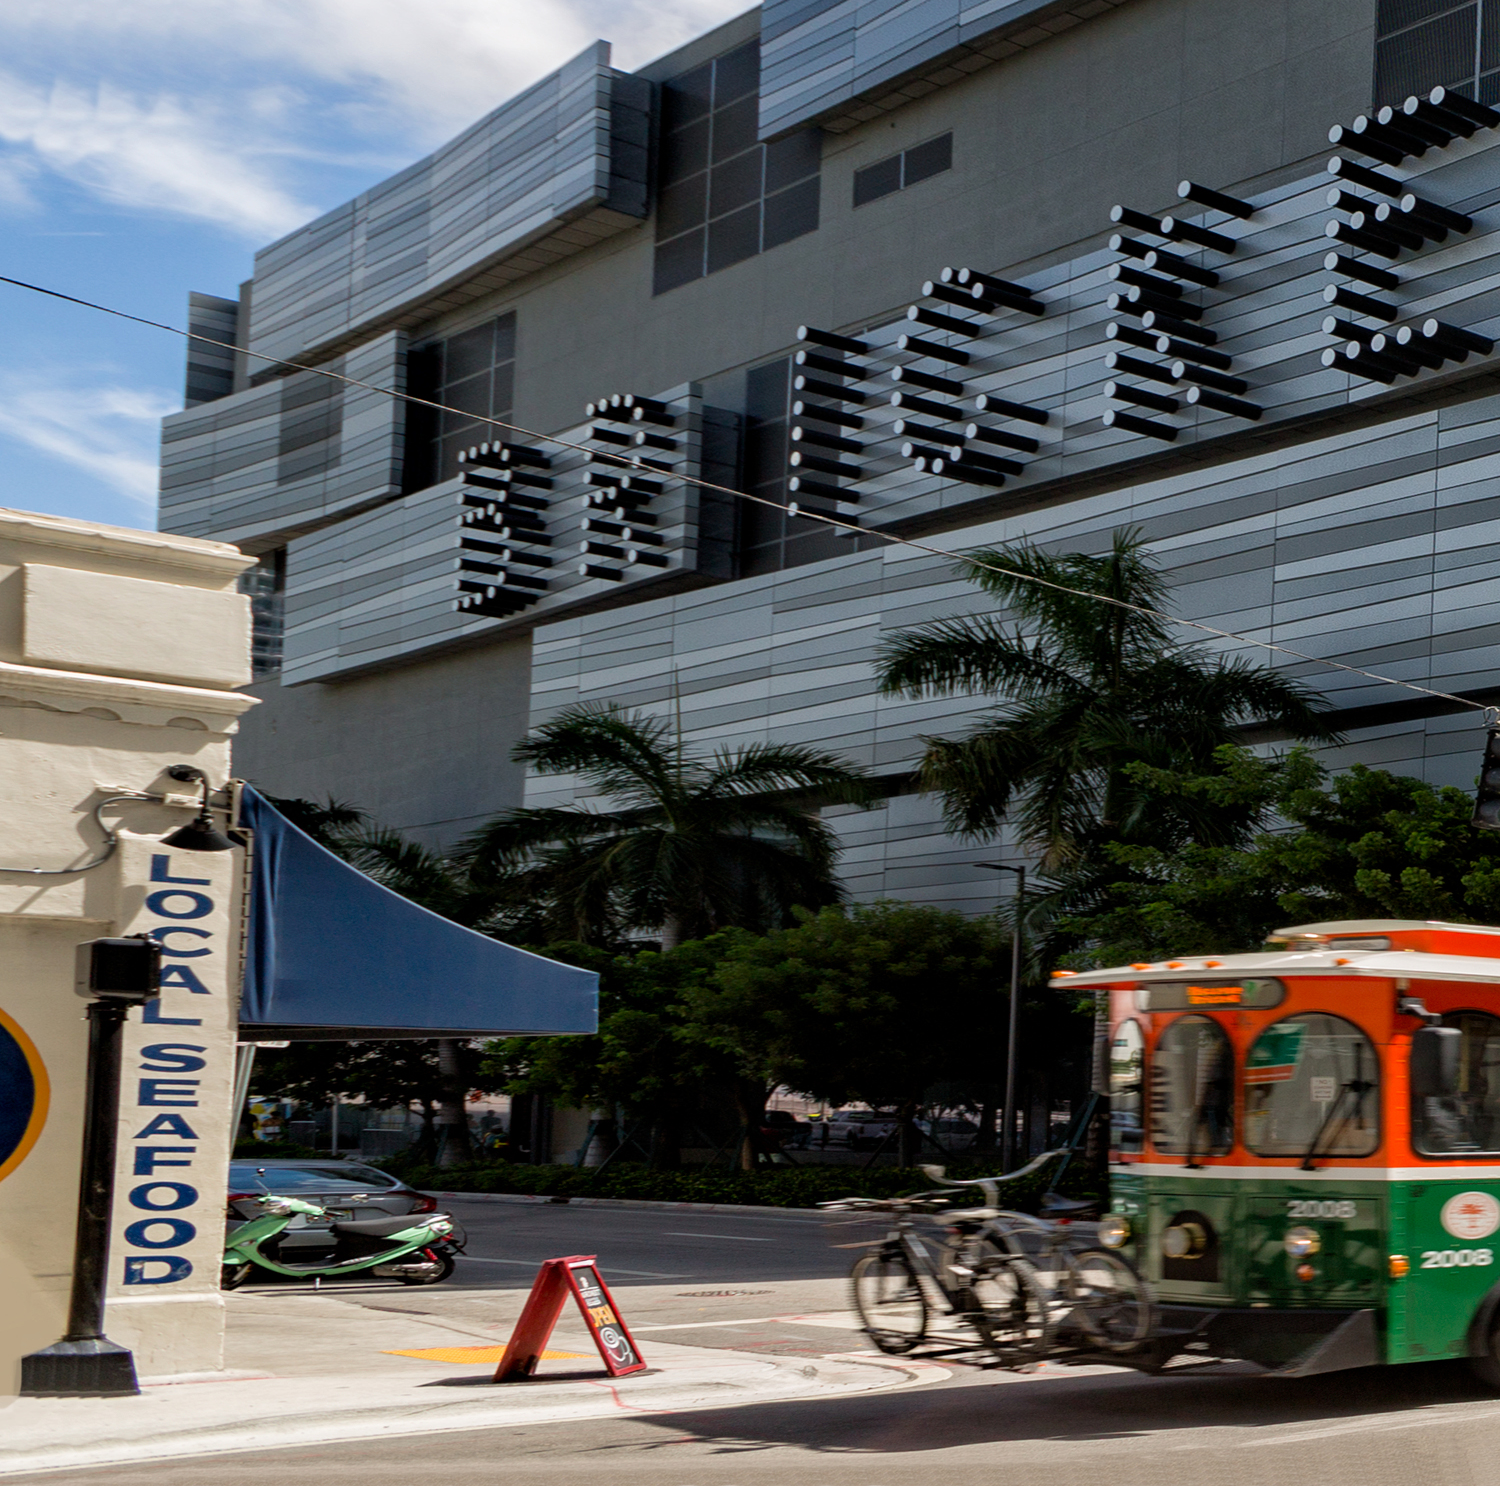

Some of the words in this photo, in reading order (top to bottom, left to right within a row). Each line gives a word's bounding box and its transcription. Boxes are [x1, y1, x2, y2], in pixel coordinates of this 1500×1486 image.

[140, 853, 215, 1026] LOCAL
[123, 1042, 208, 1286] SEAFOOD
[1287, 1200, 1357, 1219] 2008
[1420, 1248, 1494, 1269] 2008
